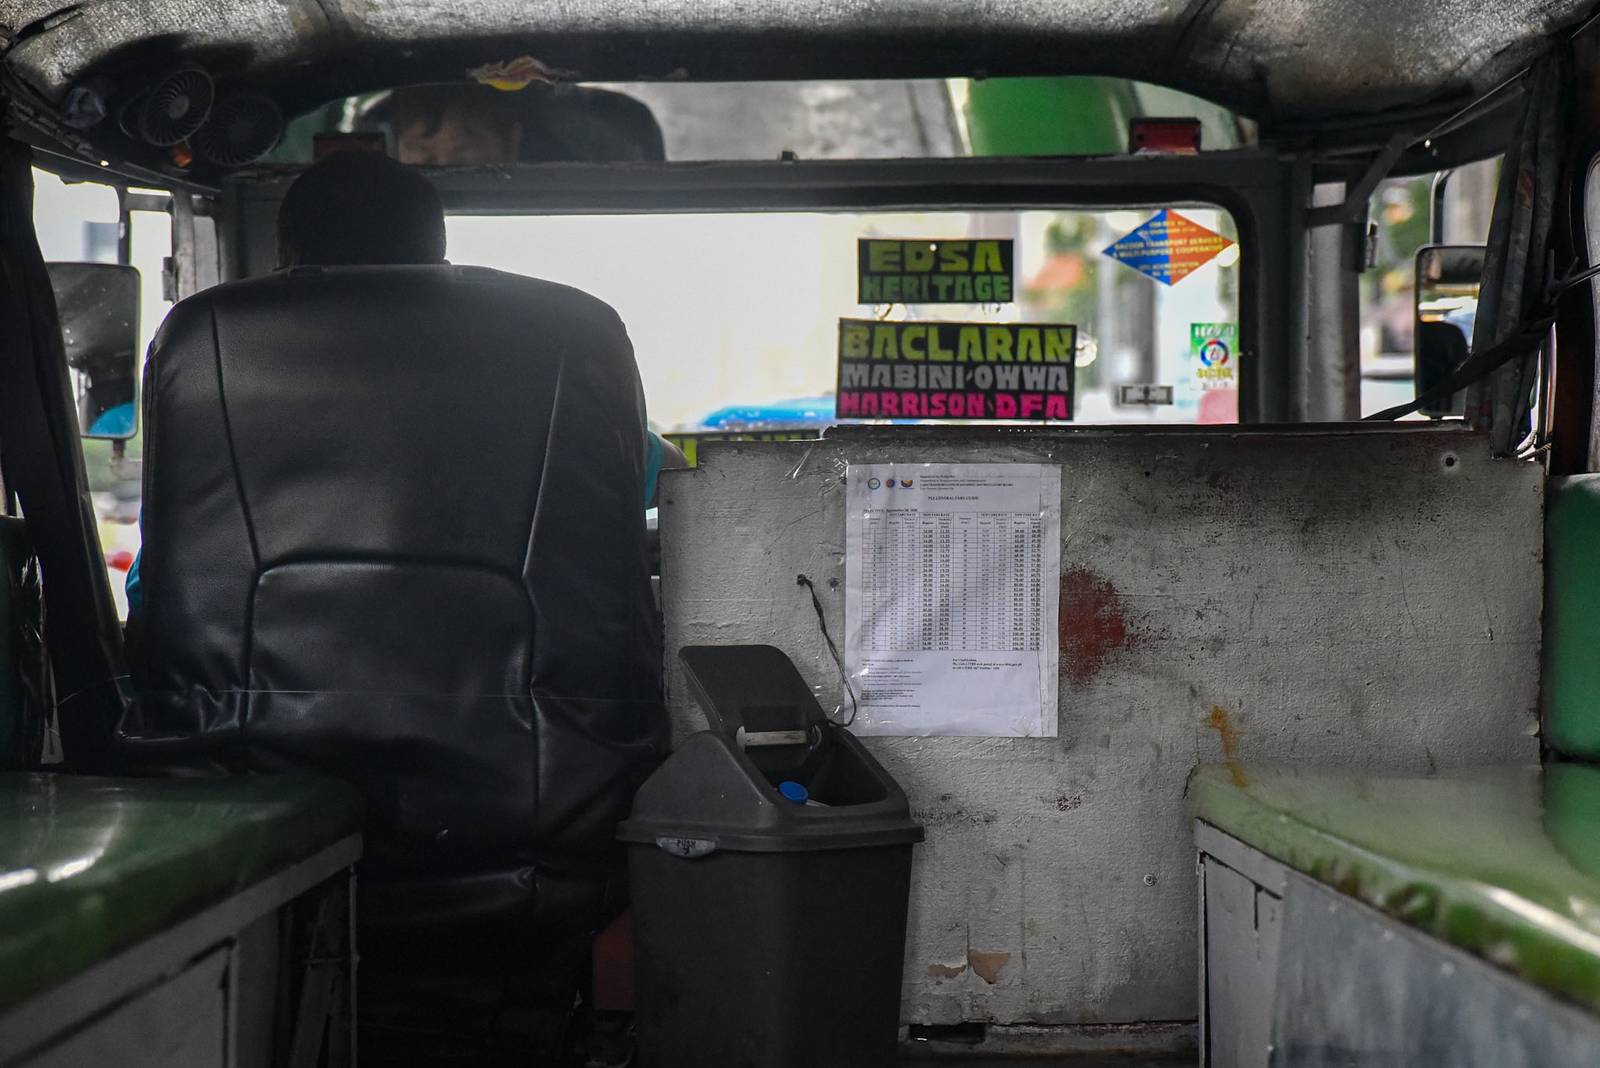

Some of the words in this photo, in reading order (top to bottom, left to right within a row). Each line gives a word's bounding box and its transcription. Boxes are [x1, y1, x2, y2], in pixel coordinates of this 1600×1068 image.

[869, 241, 1003, 273] EDSA
[863, 274, 1011, 302] HERITAGE
[843, 324, 1073, 363] BACLARAN
[839, 391, 986, 418] HARRISON
[995, 393, 1069, 419] DFA
[676, 839, 697, 849] PUSH
